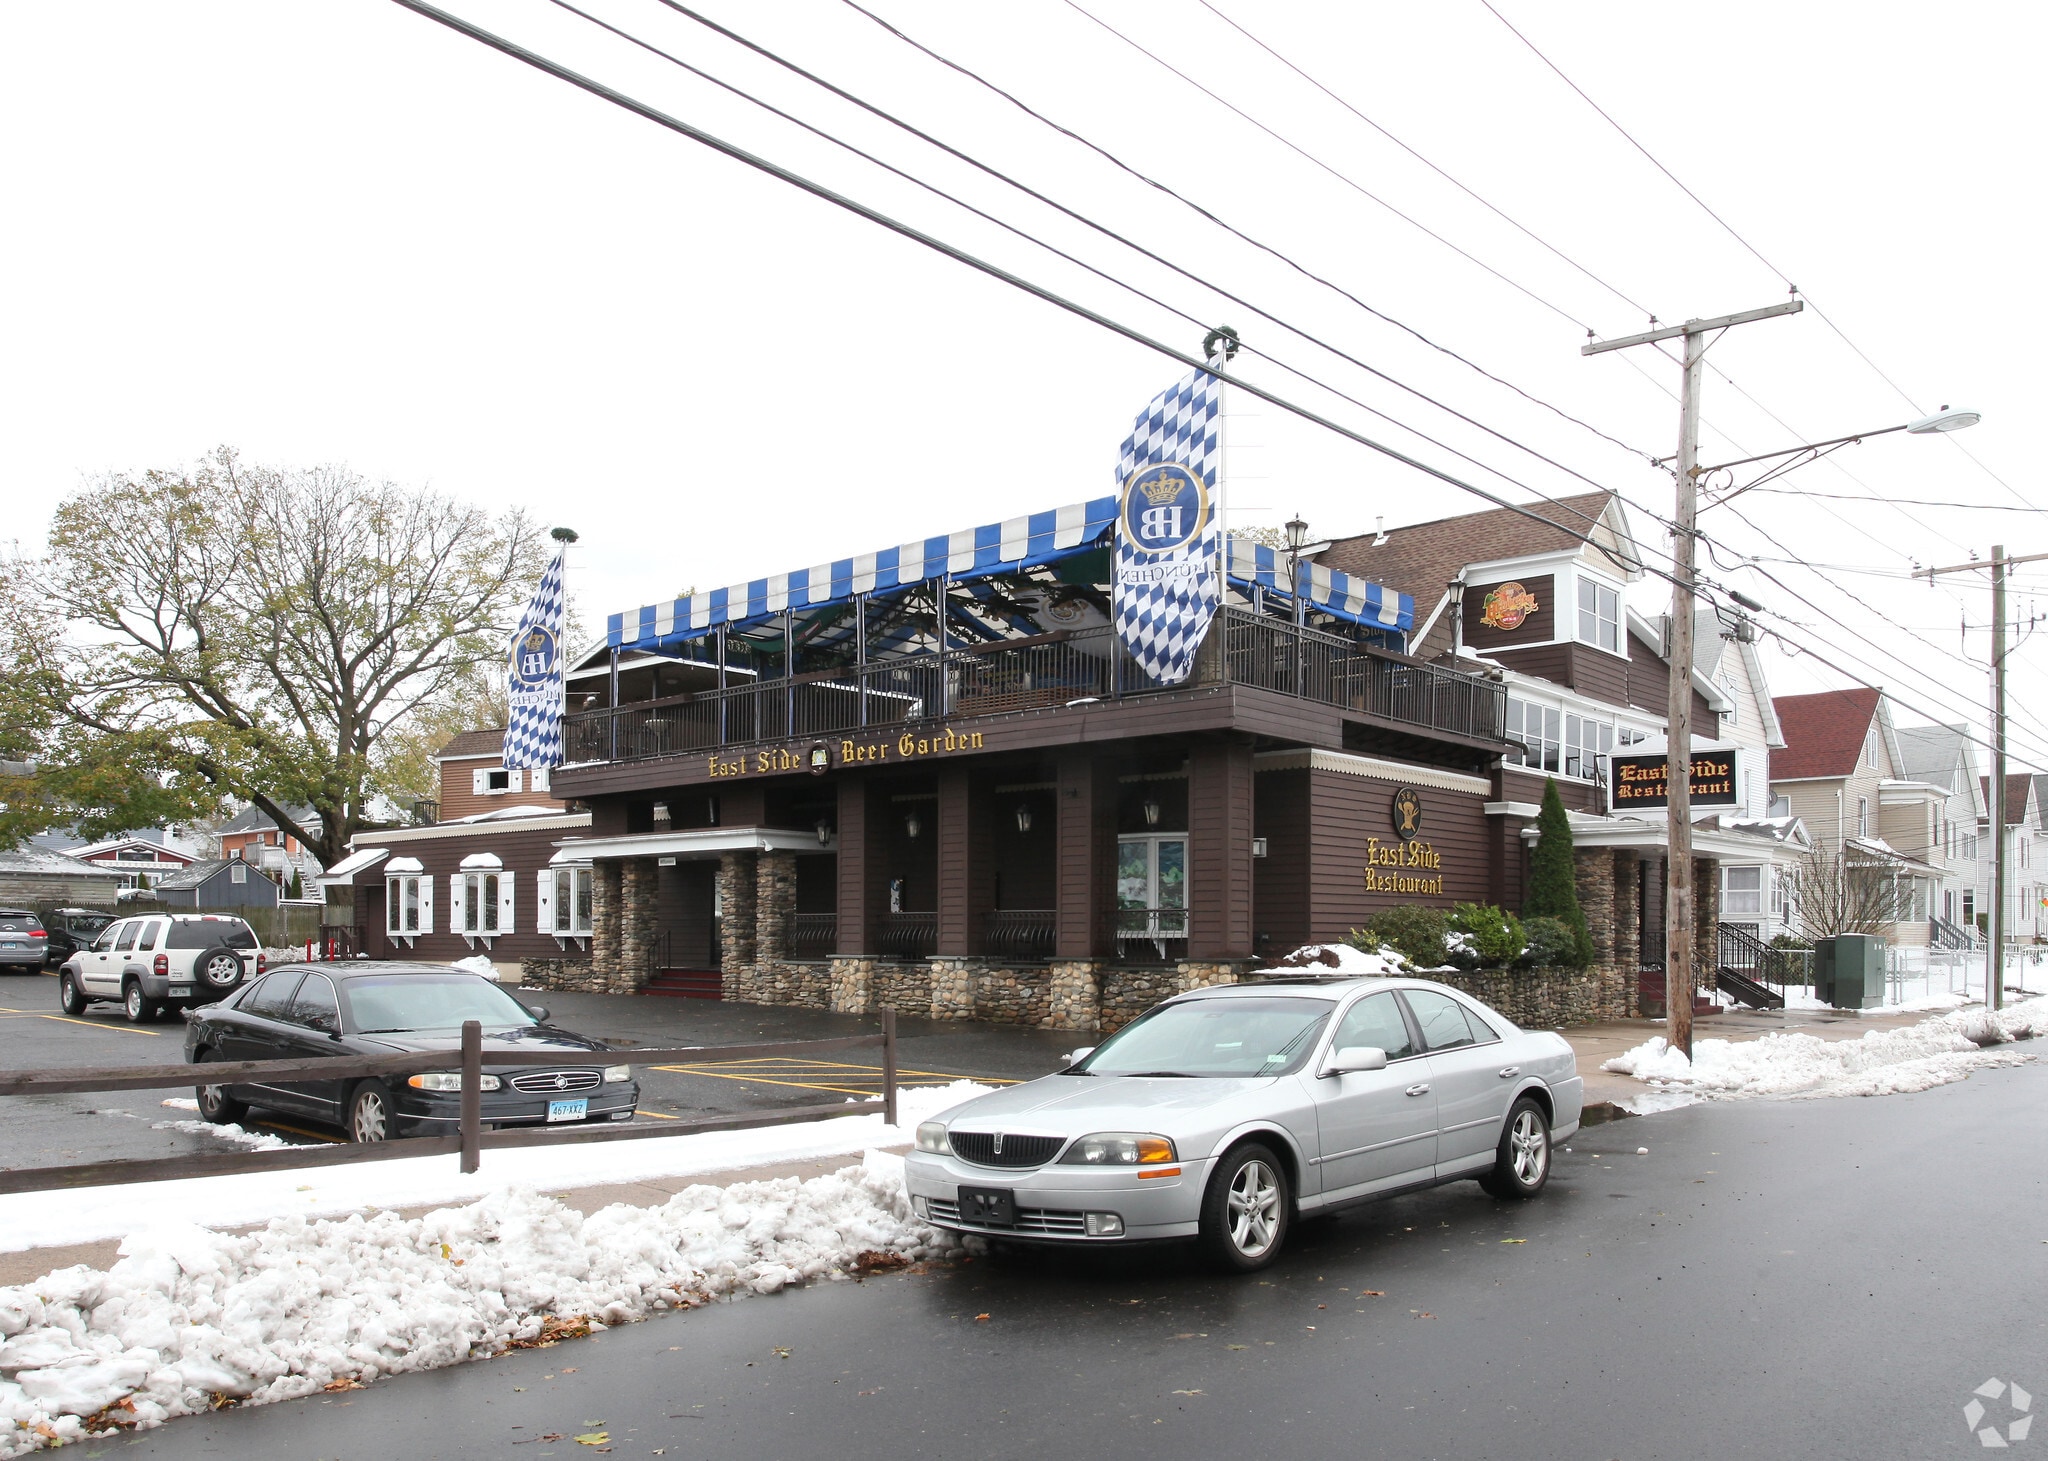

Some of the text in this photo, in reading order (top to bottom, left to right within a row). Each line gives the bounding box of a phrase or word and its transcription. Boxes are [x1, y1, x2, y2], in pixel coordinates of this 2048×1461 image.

[708, 728, 984, 778] East Side Beer Garden
[1620, 764, 1668, 781] East
[1367, 837, 1441, 870] East Side
[1364, 867, 1443, 895] Restaurant
